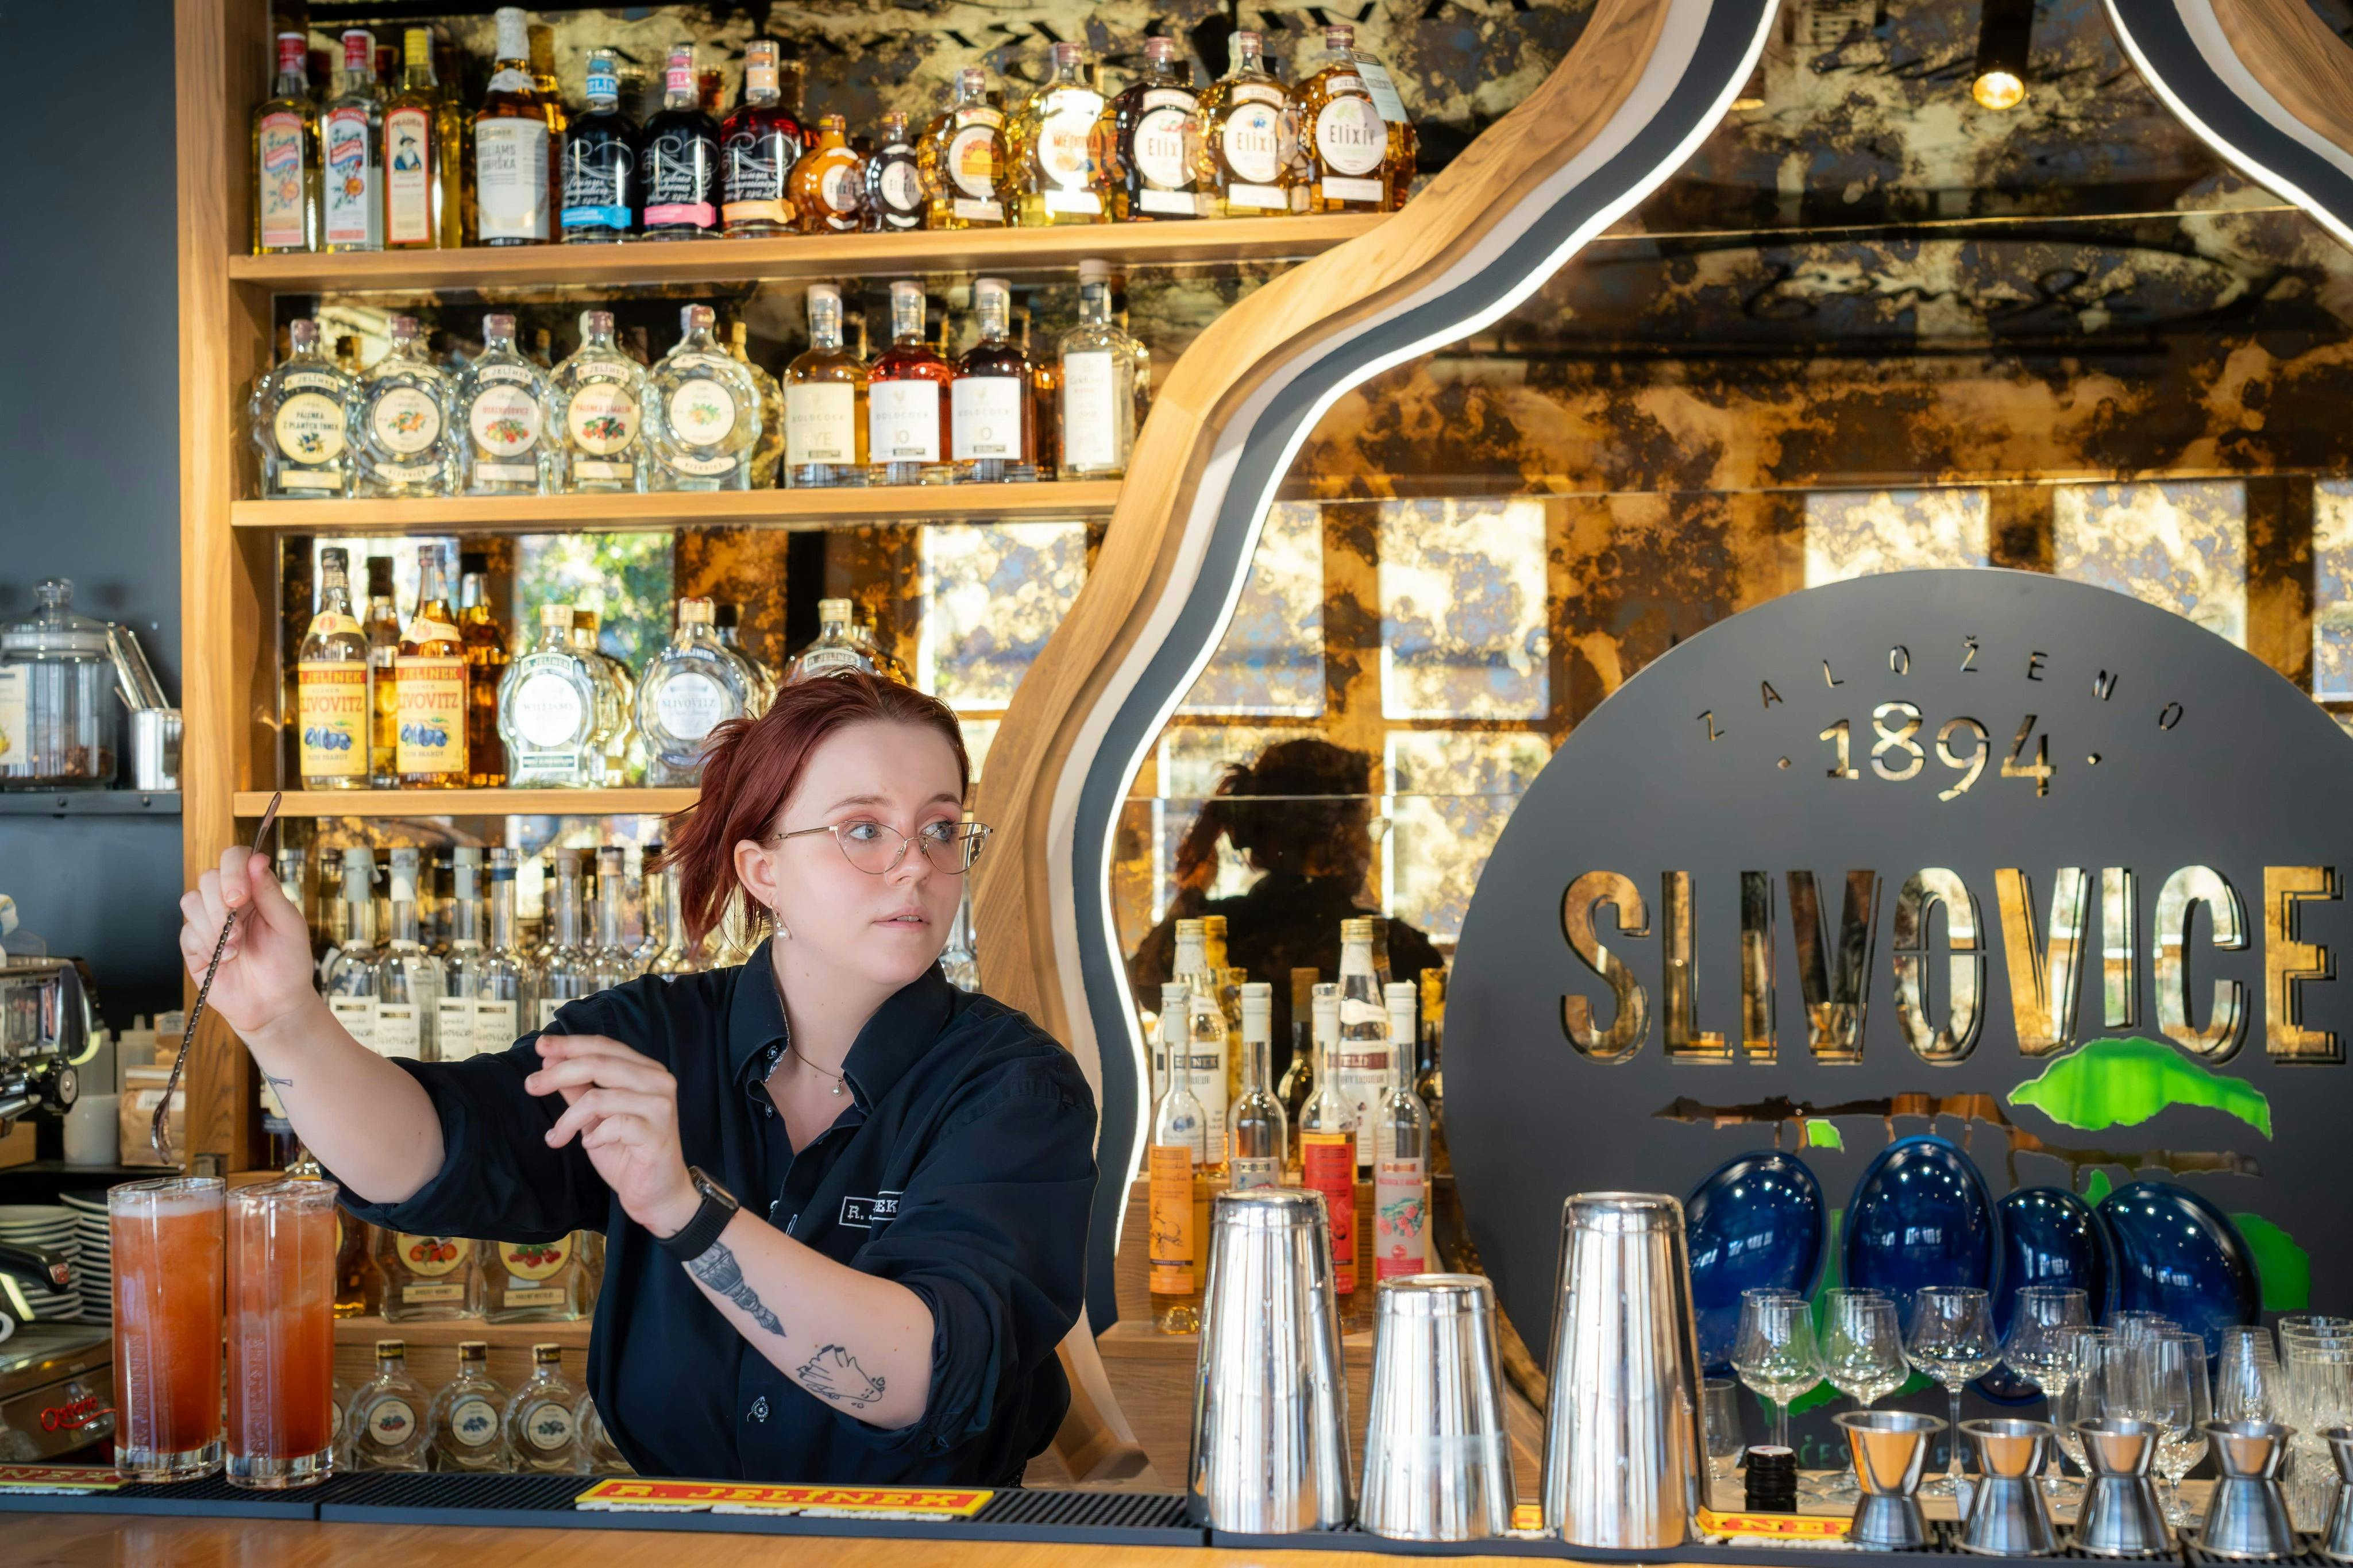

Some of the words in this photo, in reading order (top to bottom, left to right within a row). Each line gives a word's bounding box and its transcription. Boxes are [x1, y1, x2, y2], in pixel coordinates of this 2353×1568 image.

[1237, 132, 1274, 152] Elixí
[1330, 122, 1375, 145] Elixír
[1148, 137, 1176, 156] Elix
[1698, 635, 2184, 741] ZALOŽENO
[300, 696, 363, 713] LIVOVITZ
[398, 693, 458, 709] LIVOVITZ
[1819, 700, 2057, 802] 1894
[1560, 866, 2346, 1067] SLIVOVICE
